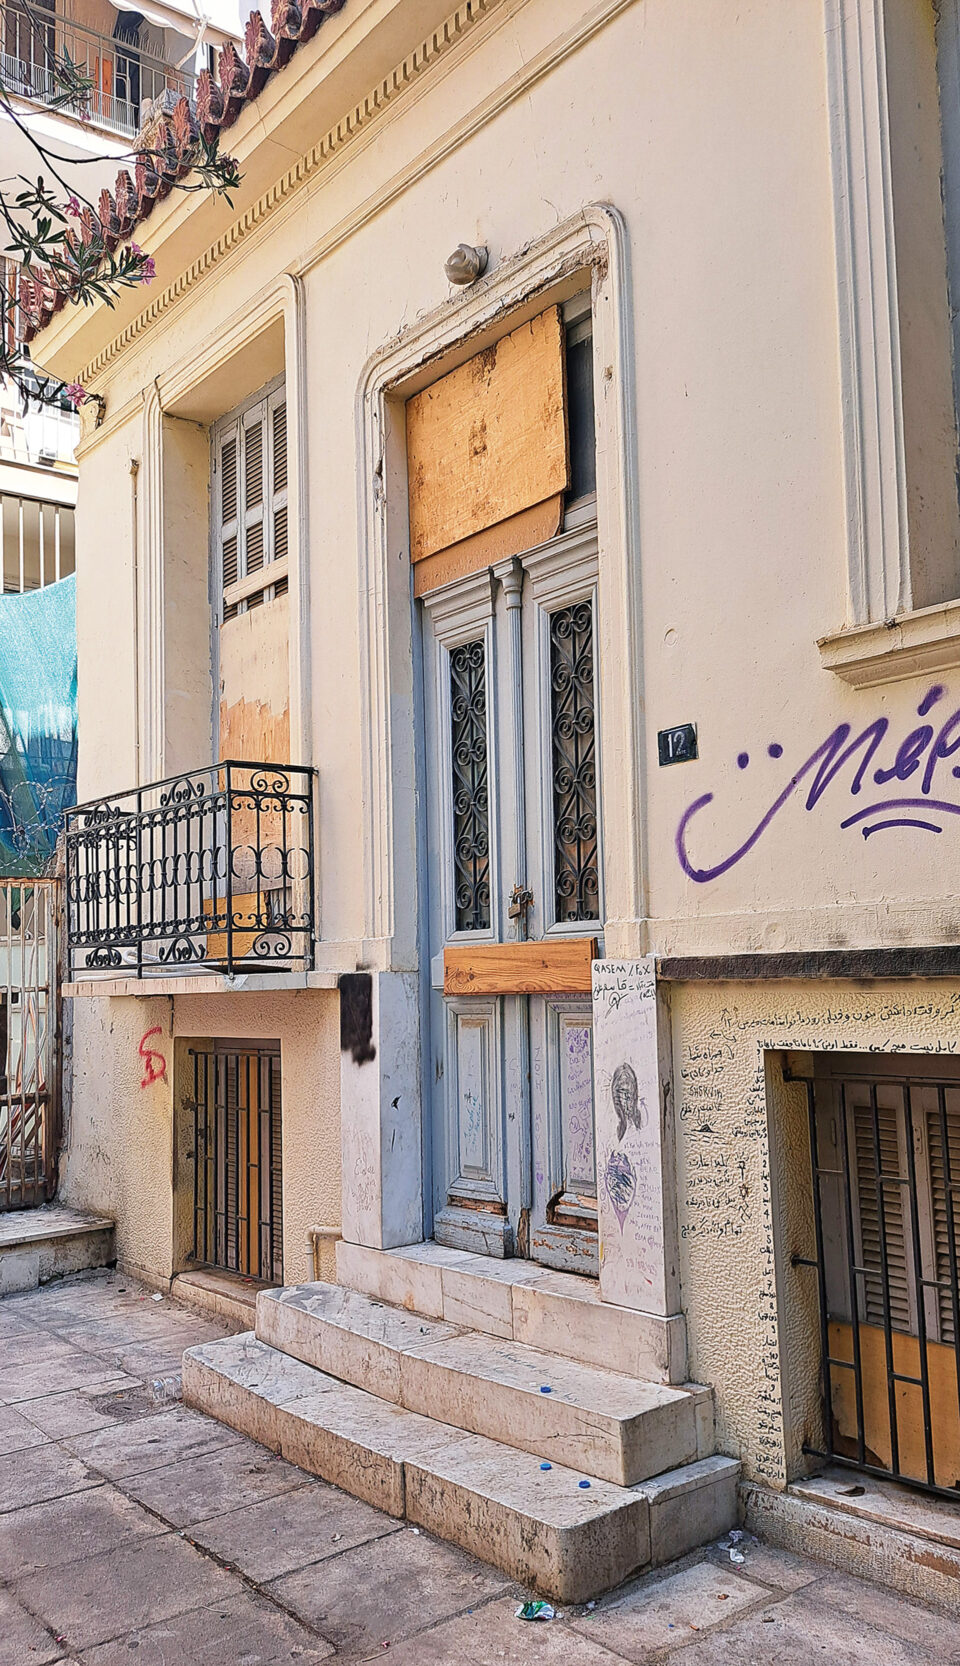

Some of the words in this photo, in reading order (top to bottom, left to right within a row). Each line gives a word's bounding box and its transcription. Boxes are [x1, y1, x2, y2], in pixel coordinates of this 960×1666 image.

[667, 731, 686, 758] 12
[594, 963, 626, 974] QASEM
[840, 1040, 858, 1050] فقط
[890, 1043, 906, 1054] هیچ
[909, 1043, 934, 1054] نیست
[762, 1159, 767, 1168] 2
[763, 1183, 768, 1192] 3
[763, 1209, 769, 1219] 4
